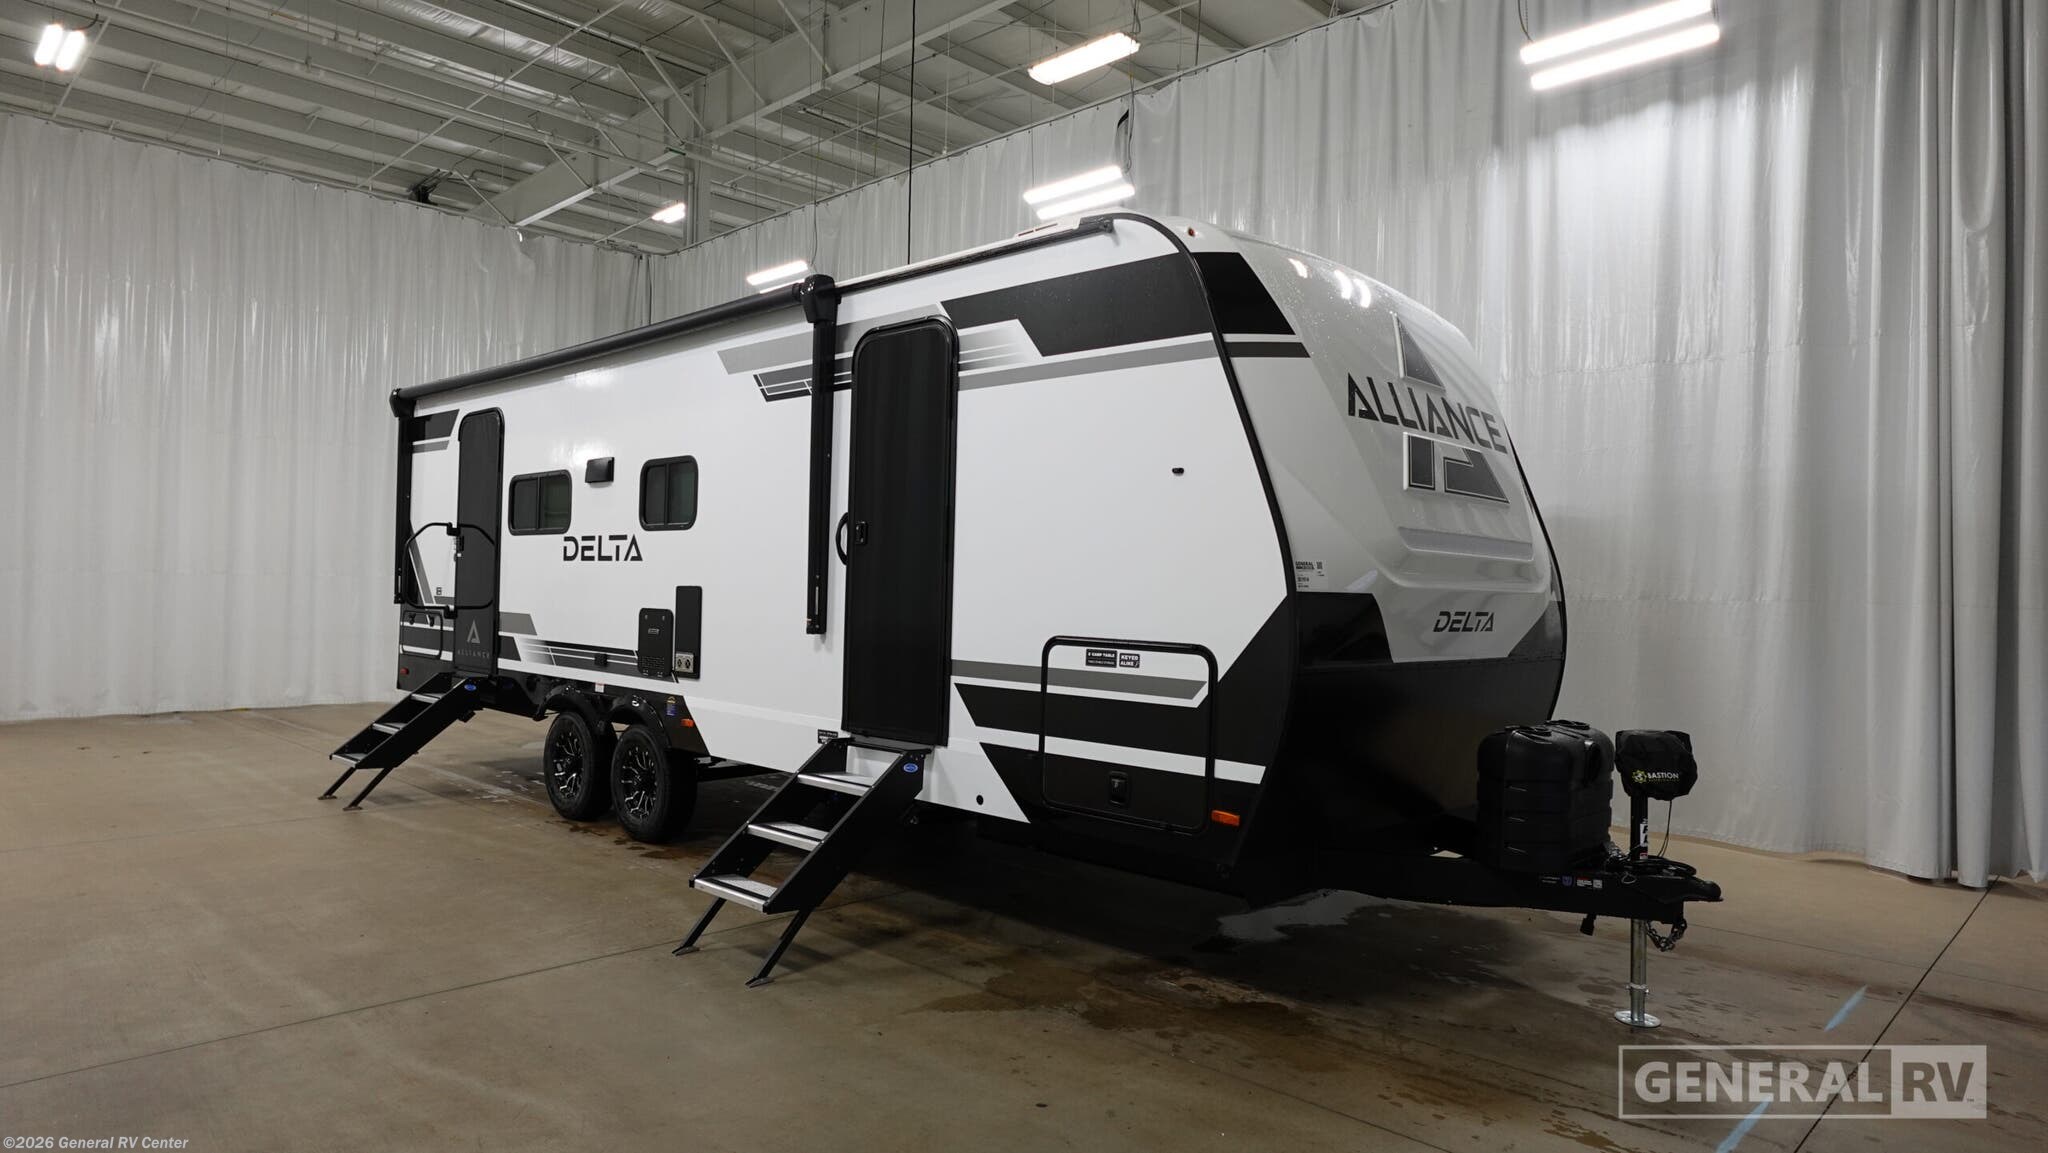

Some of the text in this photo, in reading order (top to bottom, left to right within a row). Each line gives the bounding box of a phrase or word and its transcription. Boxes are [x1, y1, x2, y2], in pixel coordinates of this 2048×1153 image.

[1348, 372, 1508, 454] ALLIANCE
[563, 534, 643, 562] DELTA
[1433, 611, 1495, 633] DELTA
